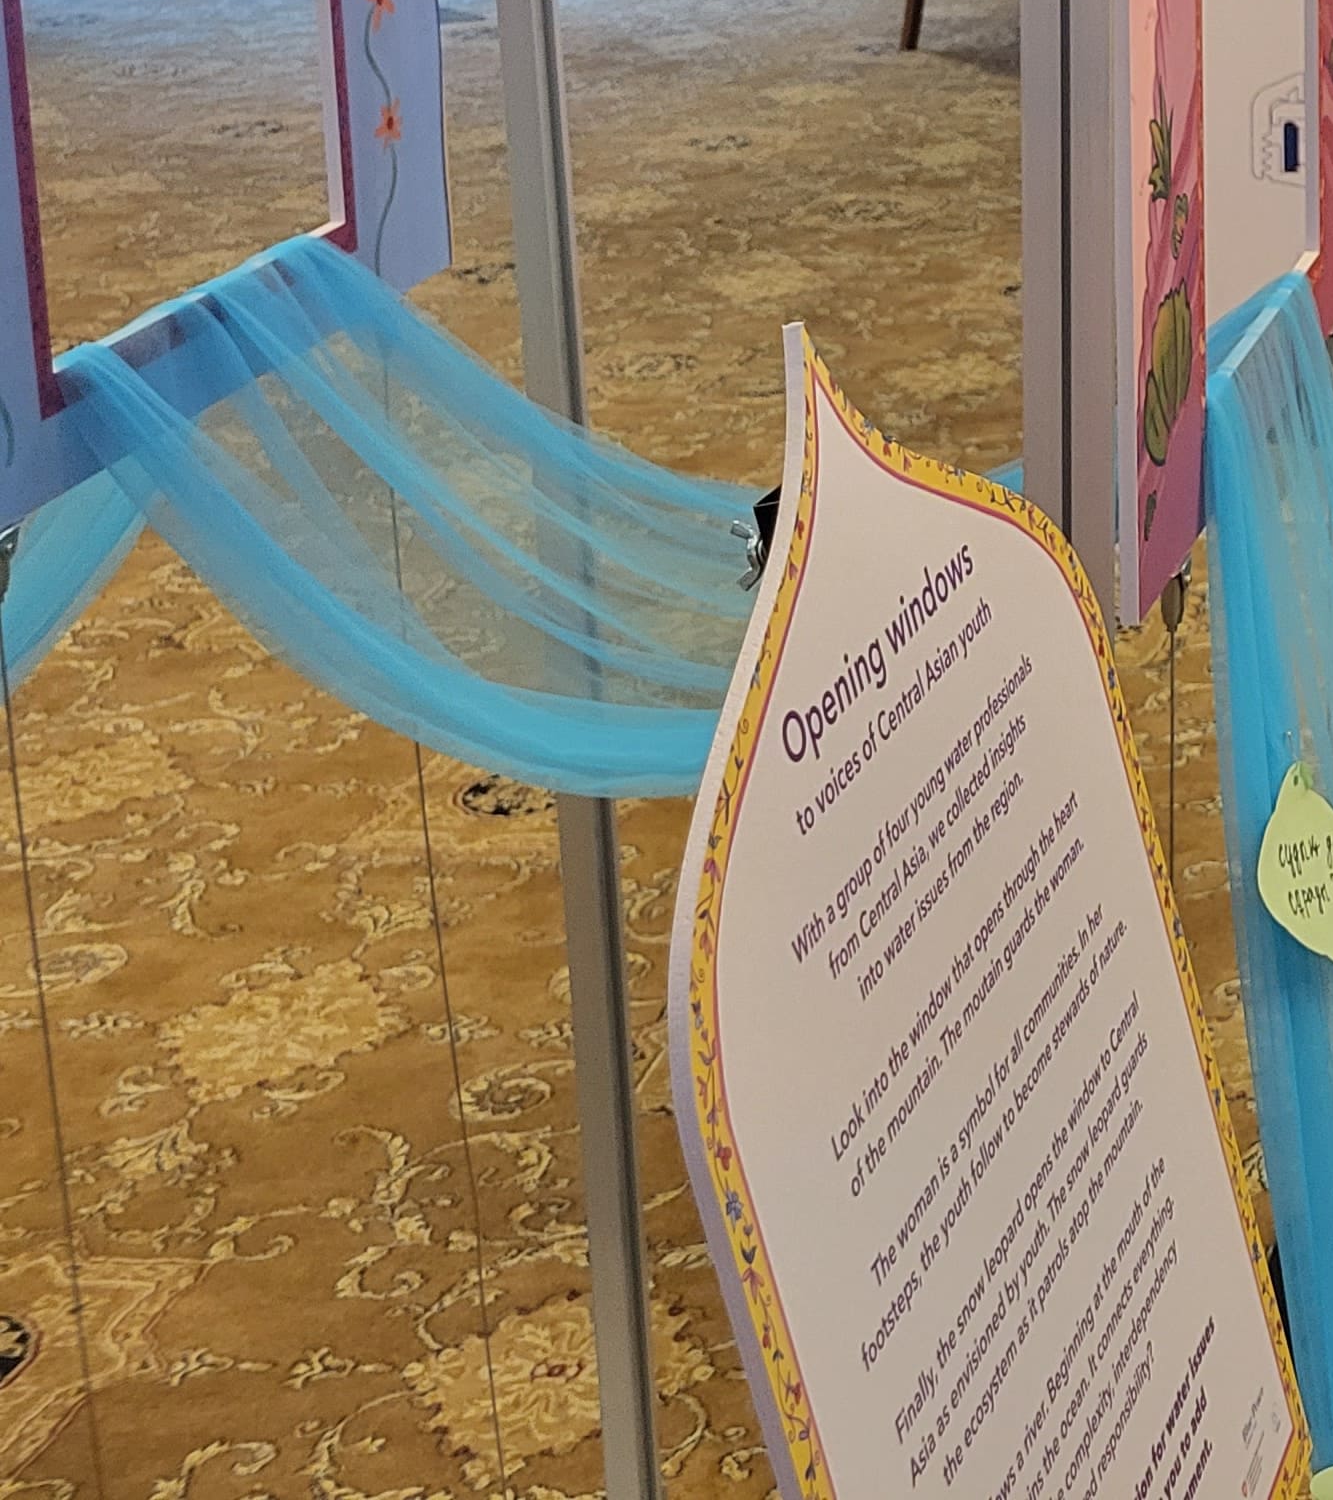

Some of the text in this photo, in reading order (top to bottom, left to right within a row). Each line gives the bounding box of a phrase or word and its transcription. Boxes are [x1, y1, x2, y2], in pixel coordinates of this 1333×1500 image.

[781, 544, 974, 764] Opening windows
[795, 596, 993, 837] to voices of Central Asian youth
[790, 653, 1033, 964] With a group of four young water professionals
[828, 713, 1027, 981] from Central Asia, we collected insights
[856, 771, 1025, 1002] into water issues from the region.
[830, 790, 1079, 1163] Look into the window that opens through the heart
[850, 837, 1085, 1198] of the mountain. The moutain guards the woman.
[869, 902, 1104, 1287] The woman is a symbol for all communities. In her
[860, 920, 1128, 1373] footsteps, the youth follow to become stewards of nature.
[894, 989, 1140, 1445] Finally, the snow leopard opens the window to Central
[910, 1031, 1149, 1487] Asia as envisioned by youth. The snow leopard guards
[943, 1099, 1144, 1486] the ecosystem as it patrols atop the mountain.
[1015, 1156, 1165, 1472] a river. Beginning at the mouth of the
[1042, 1436, 1061, 1475] the
[1059, 1377, 1091, 1440] ocean.
[1087, 1353, 1099, 1379] It
[1096, 1279, 1134, 1361] connects
[1132, 1195, 1175, 1285] everything.
[1065, 1238, 1178, 1500] complexity, interdependency
[1097, 1339, 1155, 1481] responsibility?
[1150, 1315, 1216, 1471] for water issues
[1179, 1431, 1192, 1460] to
[1189, 1384, 1208, 1437] add
